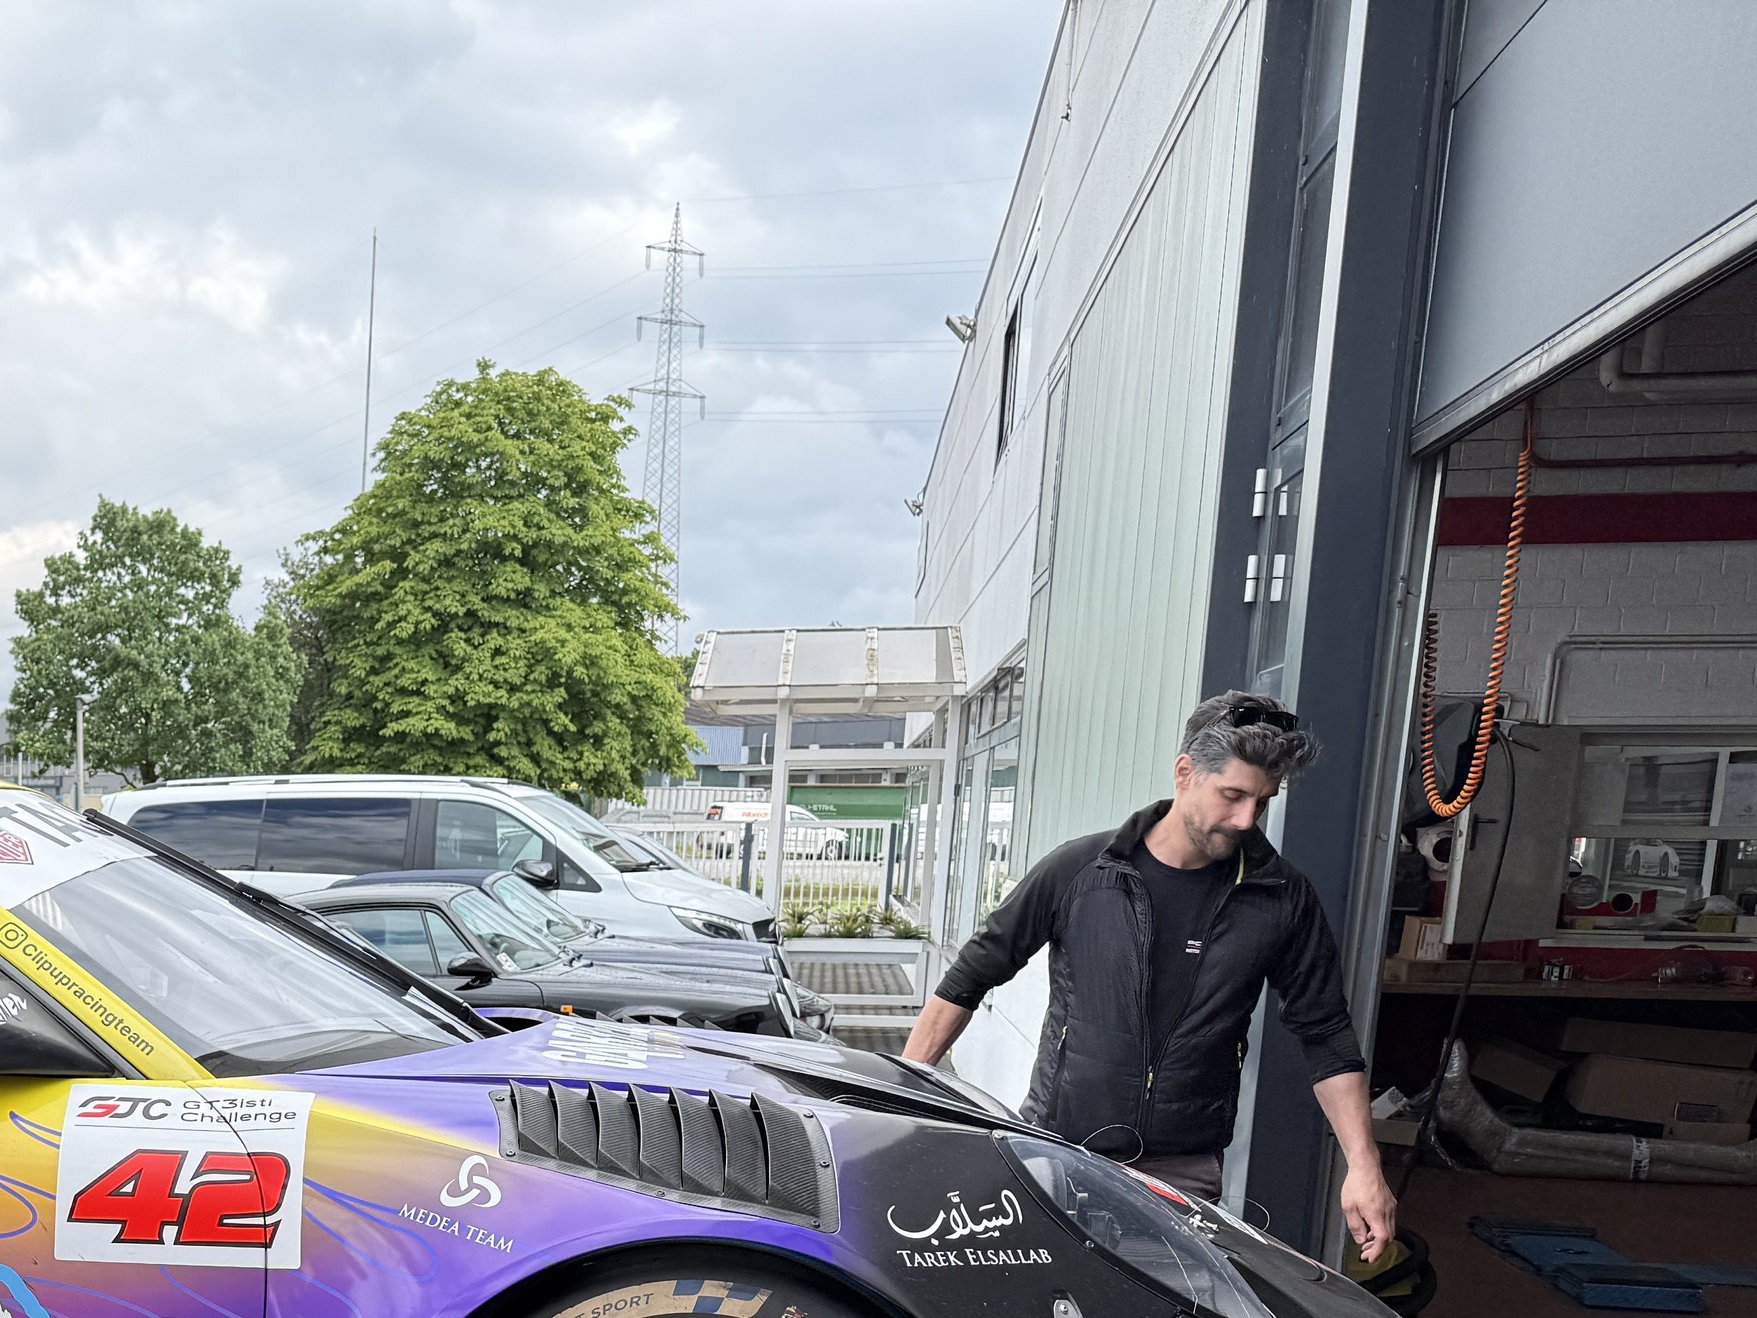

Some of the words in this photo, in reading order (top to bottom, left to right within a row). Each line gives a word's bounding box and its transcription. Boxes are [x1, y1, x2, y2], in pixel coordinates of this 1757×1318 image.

[22, 943, 155, 1056] Clipupracingteam
[181, 1111, 297, 1124] Challenge
[67, 1149, 291, 1249] 42
[398, 1203, 460, 1237] MEDEA
[466, 1225, 514, 1253] TEAM
